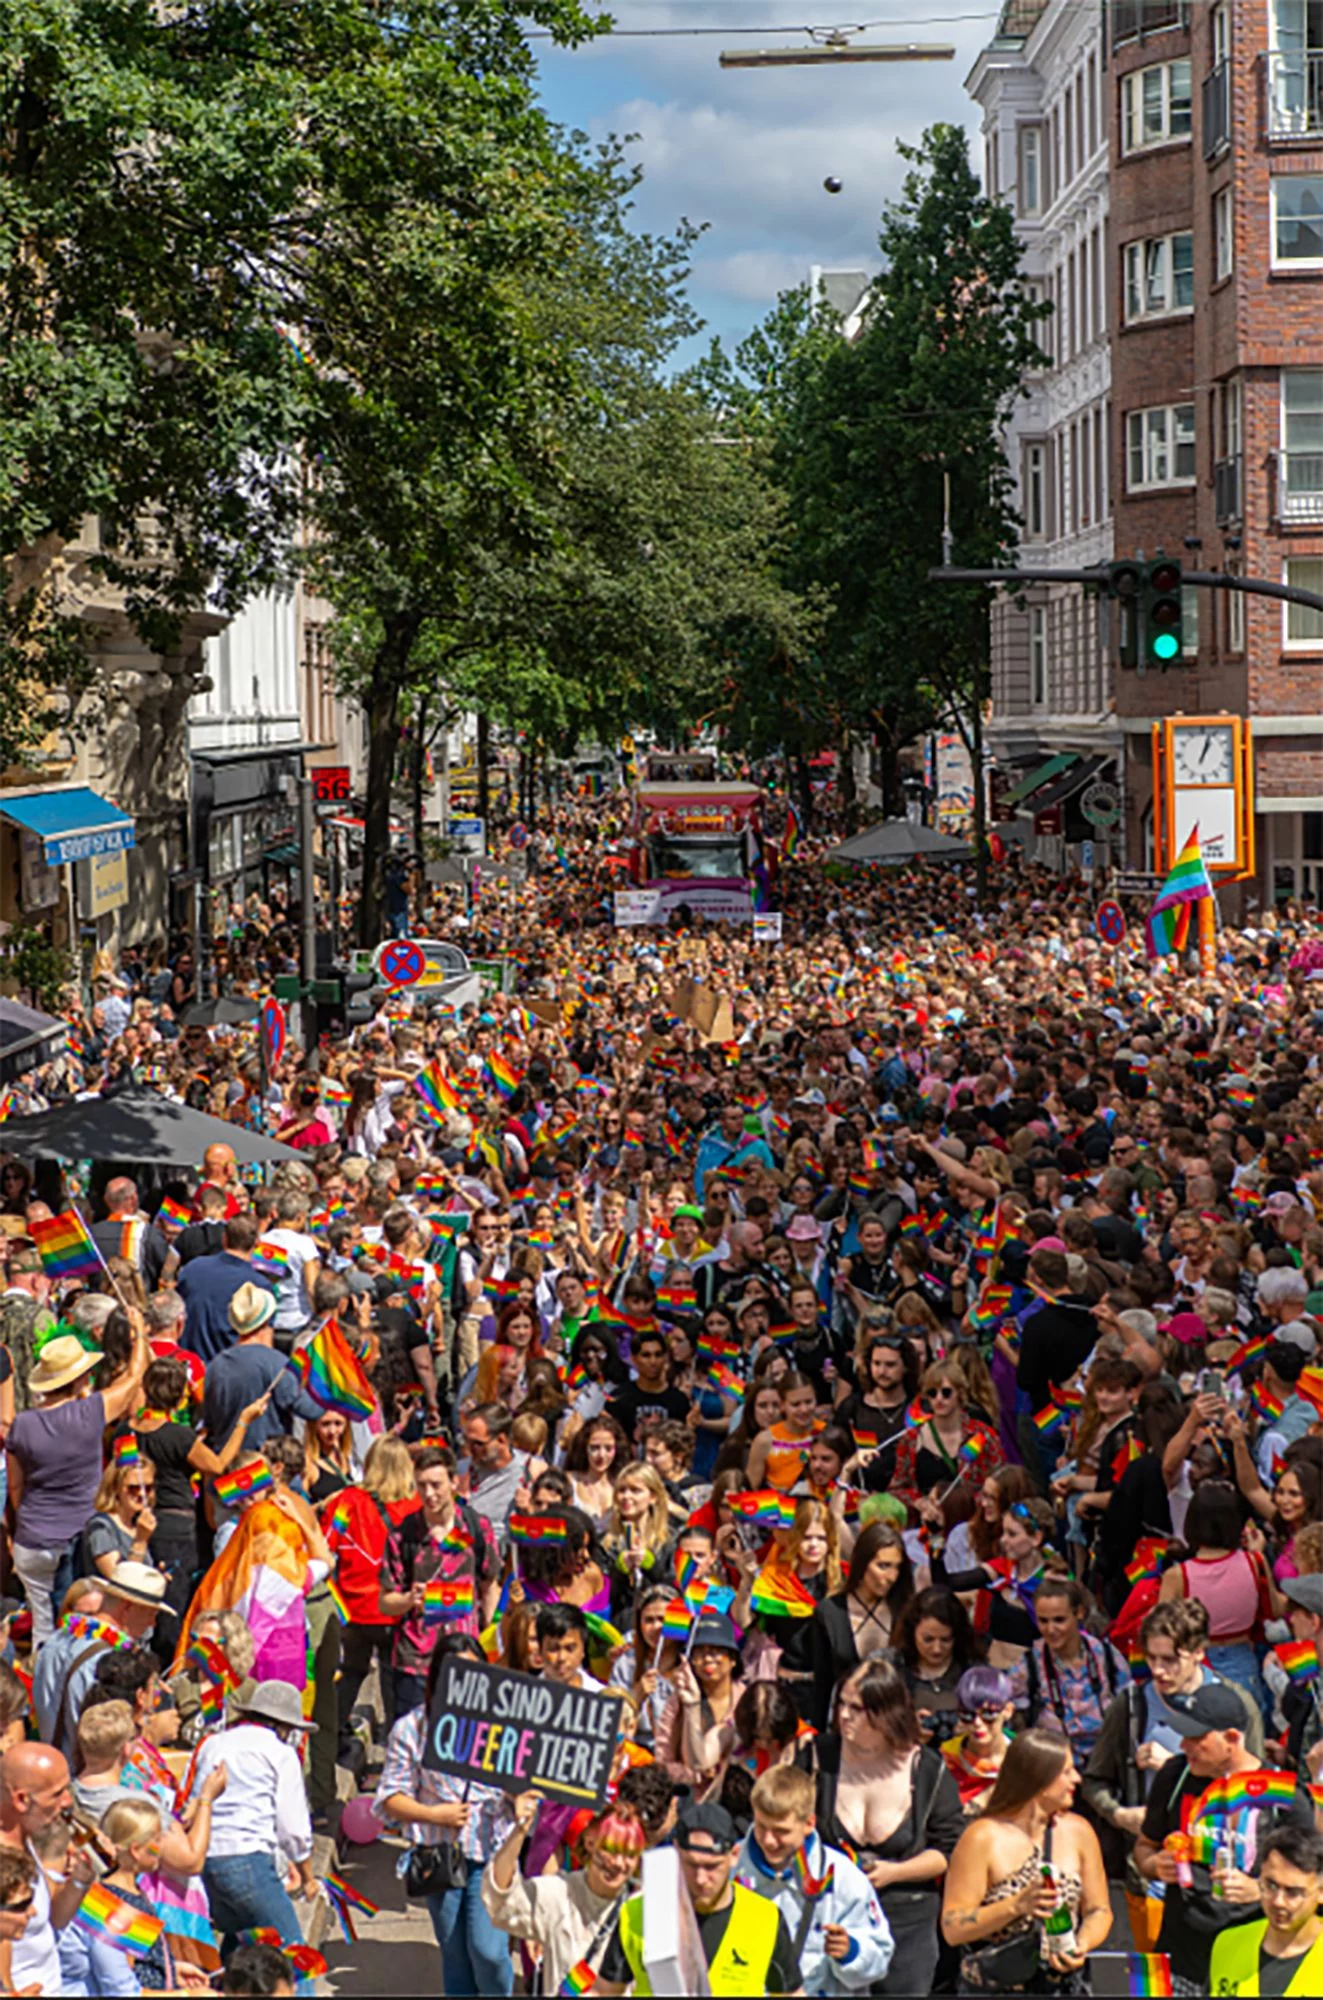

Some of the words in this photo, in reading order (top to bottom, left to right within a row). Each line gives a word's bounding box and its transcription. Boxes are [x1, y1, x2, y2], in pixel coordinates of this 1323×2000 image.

[446, 1667, 490, 1712] WIR
[492, 1680, 553, 1725] SIND
[552, 1693, 615, 1740] ALLE
[433, 1713, 535, 1778] QUEERE
[535, 1732, 607, 1790] TIERE
